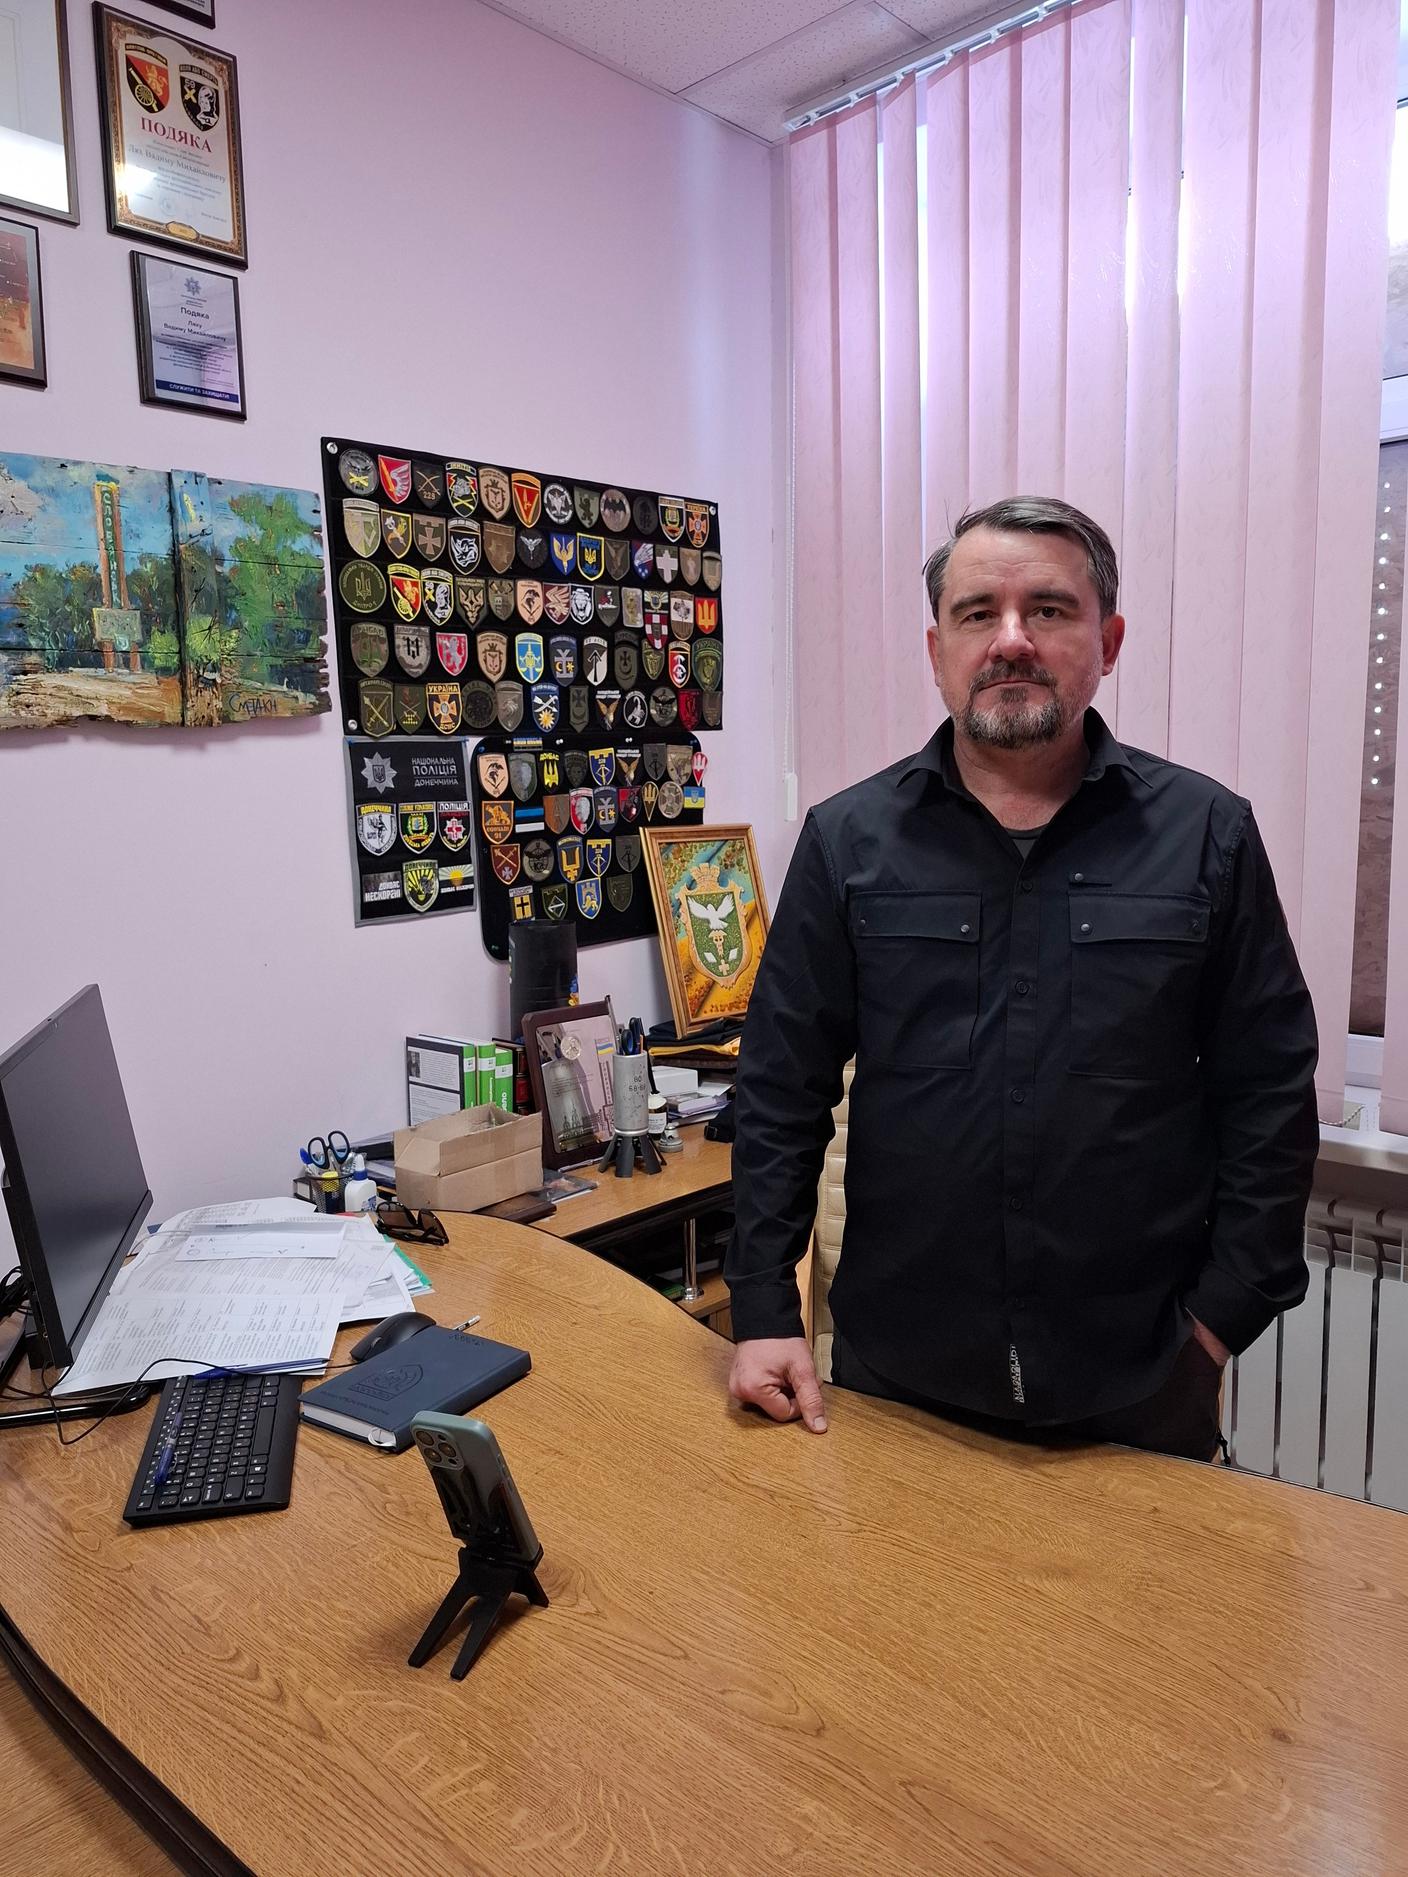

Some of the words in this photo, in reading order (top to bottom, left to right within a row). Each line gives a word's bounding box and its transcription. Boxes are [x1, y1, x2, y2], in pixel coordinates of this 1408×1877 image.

[141, 117, 212, 153] ПОДЯКА
[180, 306, 210, 320] Подяка
[428, 685, 458, 693] УКРАЇНА
[411, 757, 456, 766] НАЦІОНАЛЬНА
[412, 765, 457, 776] ПОЛІЦІЯ
[414, 778, 459, 787] ДОНЕЧЧИНА
[440, 802, 469, 810] ПОЛІЦІЯ
